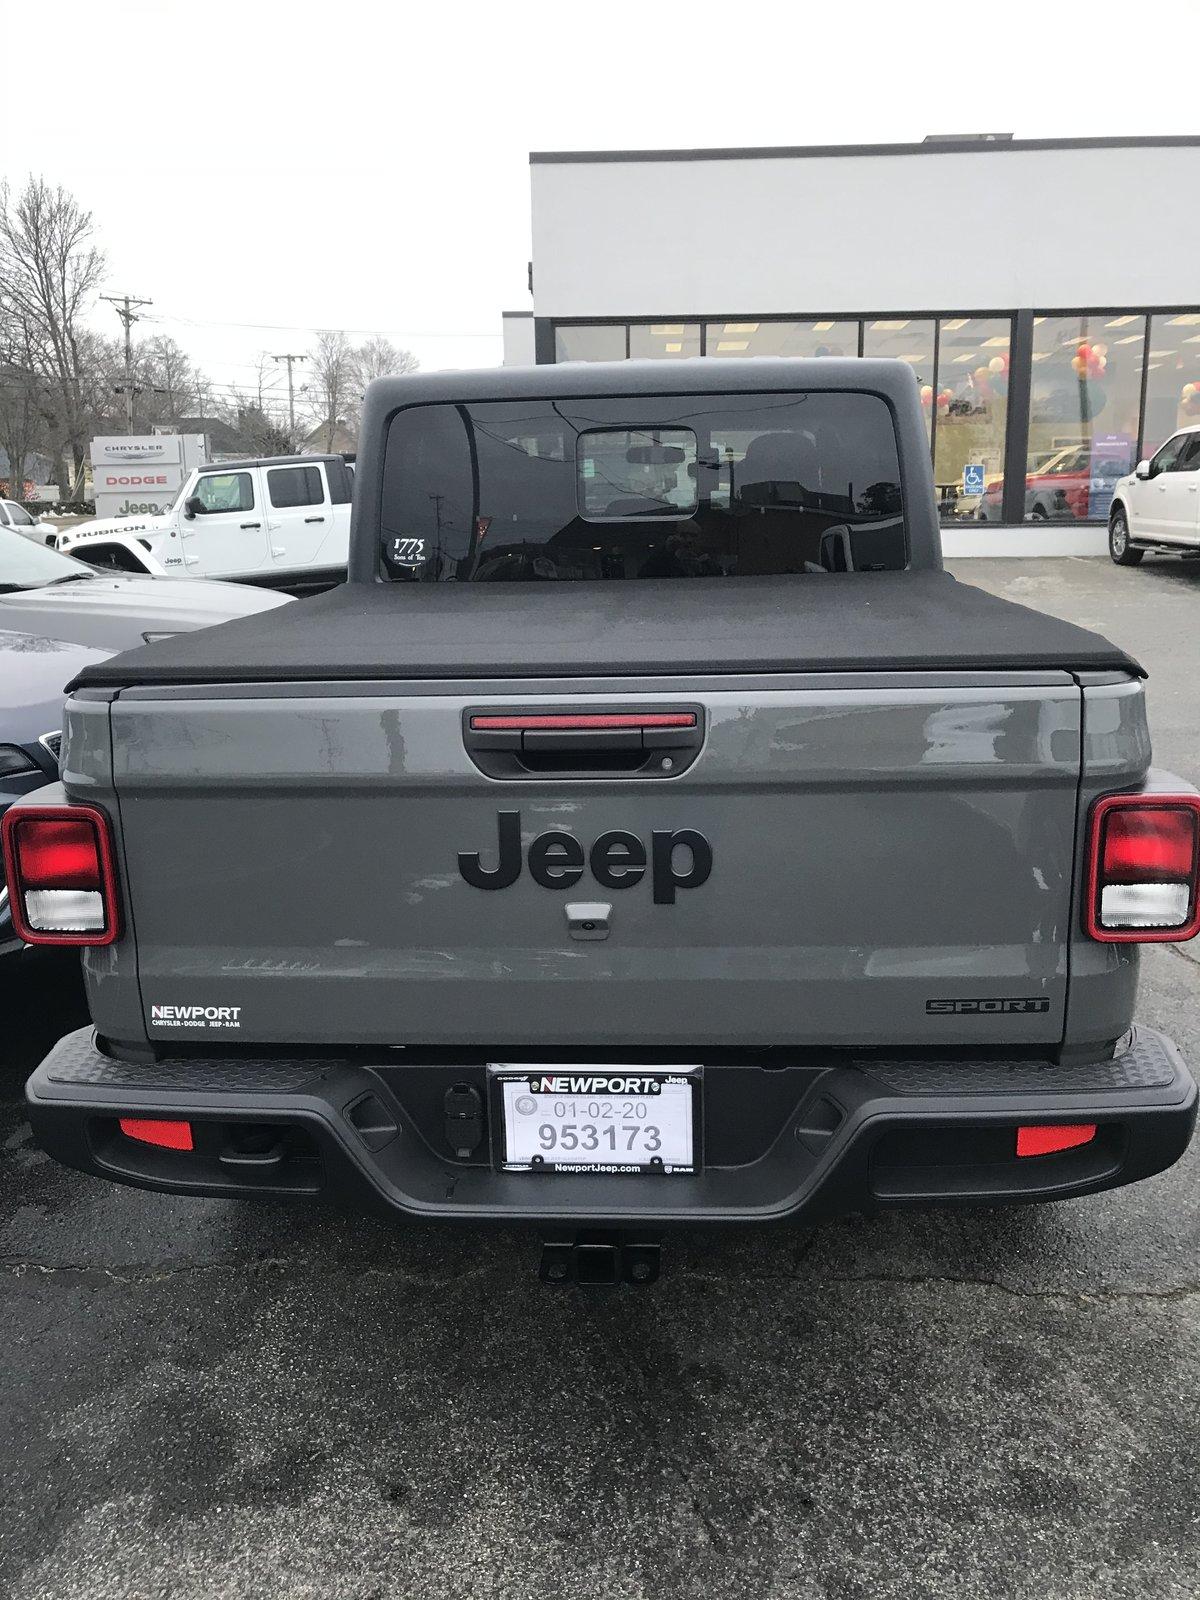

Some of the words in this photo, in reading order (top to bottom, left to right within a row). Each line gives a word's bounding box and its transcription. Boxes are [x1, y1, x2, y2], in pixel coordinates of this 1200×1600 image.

[106, 476, 168, 485] DODGE
[119, 500, 159, 515] Jeep
[76, 525, 146, 539] RUBICON
[394, 538, 424, 554] 1775
[165, 557, 182, 565] Jeep
[457, 810, 713, 904] Jeep
[151, 1005, 241, 1020] NEWPORT
[926, 998, 1050, 1014] SPORT
[540, 1076, 654, 1093] NEWPORT
[664, 1075, 688, 1085] Jeep
[554, 1101, 648, 1119] 01-02-20
[538, 1123, 662, 1151] 953173
[554, 1163, 641, 1174] NewportJeep.com
